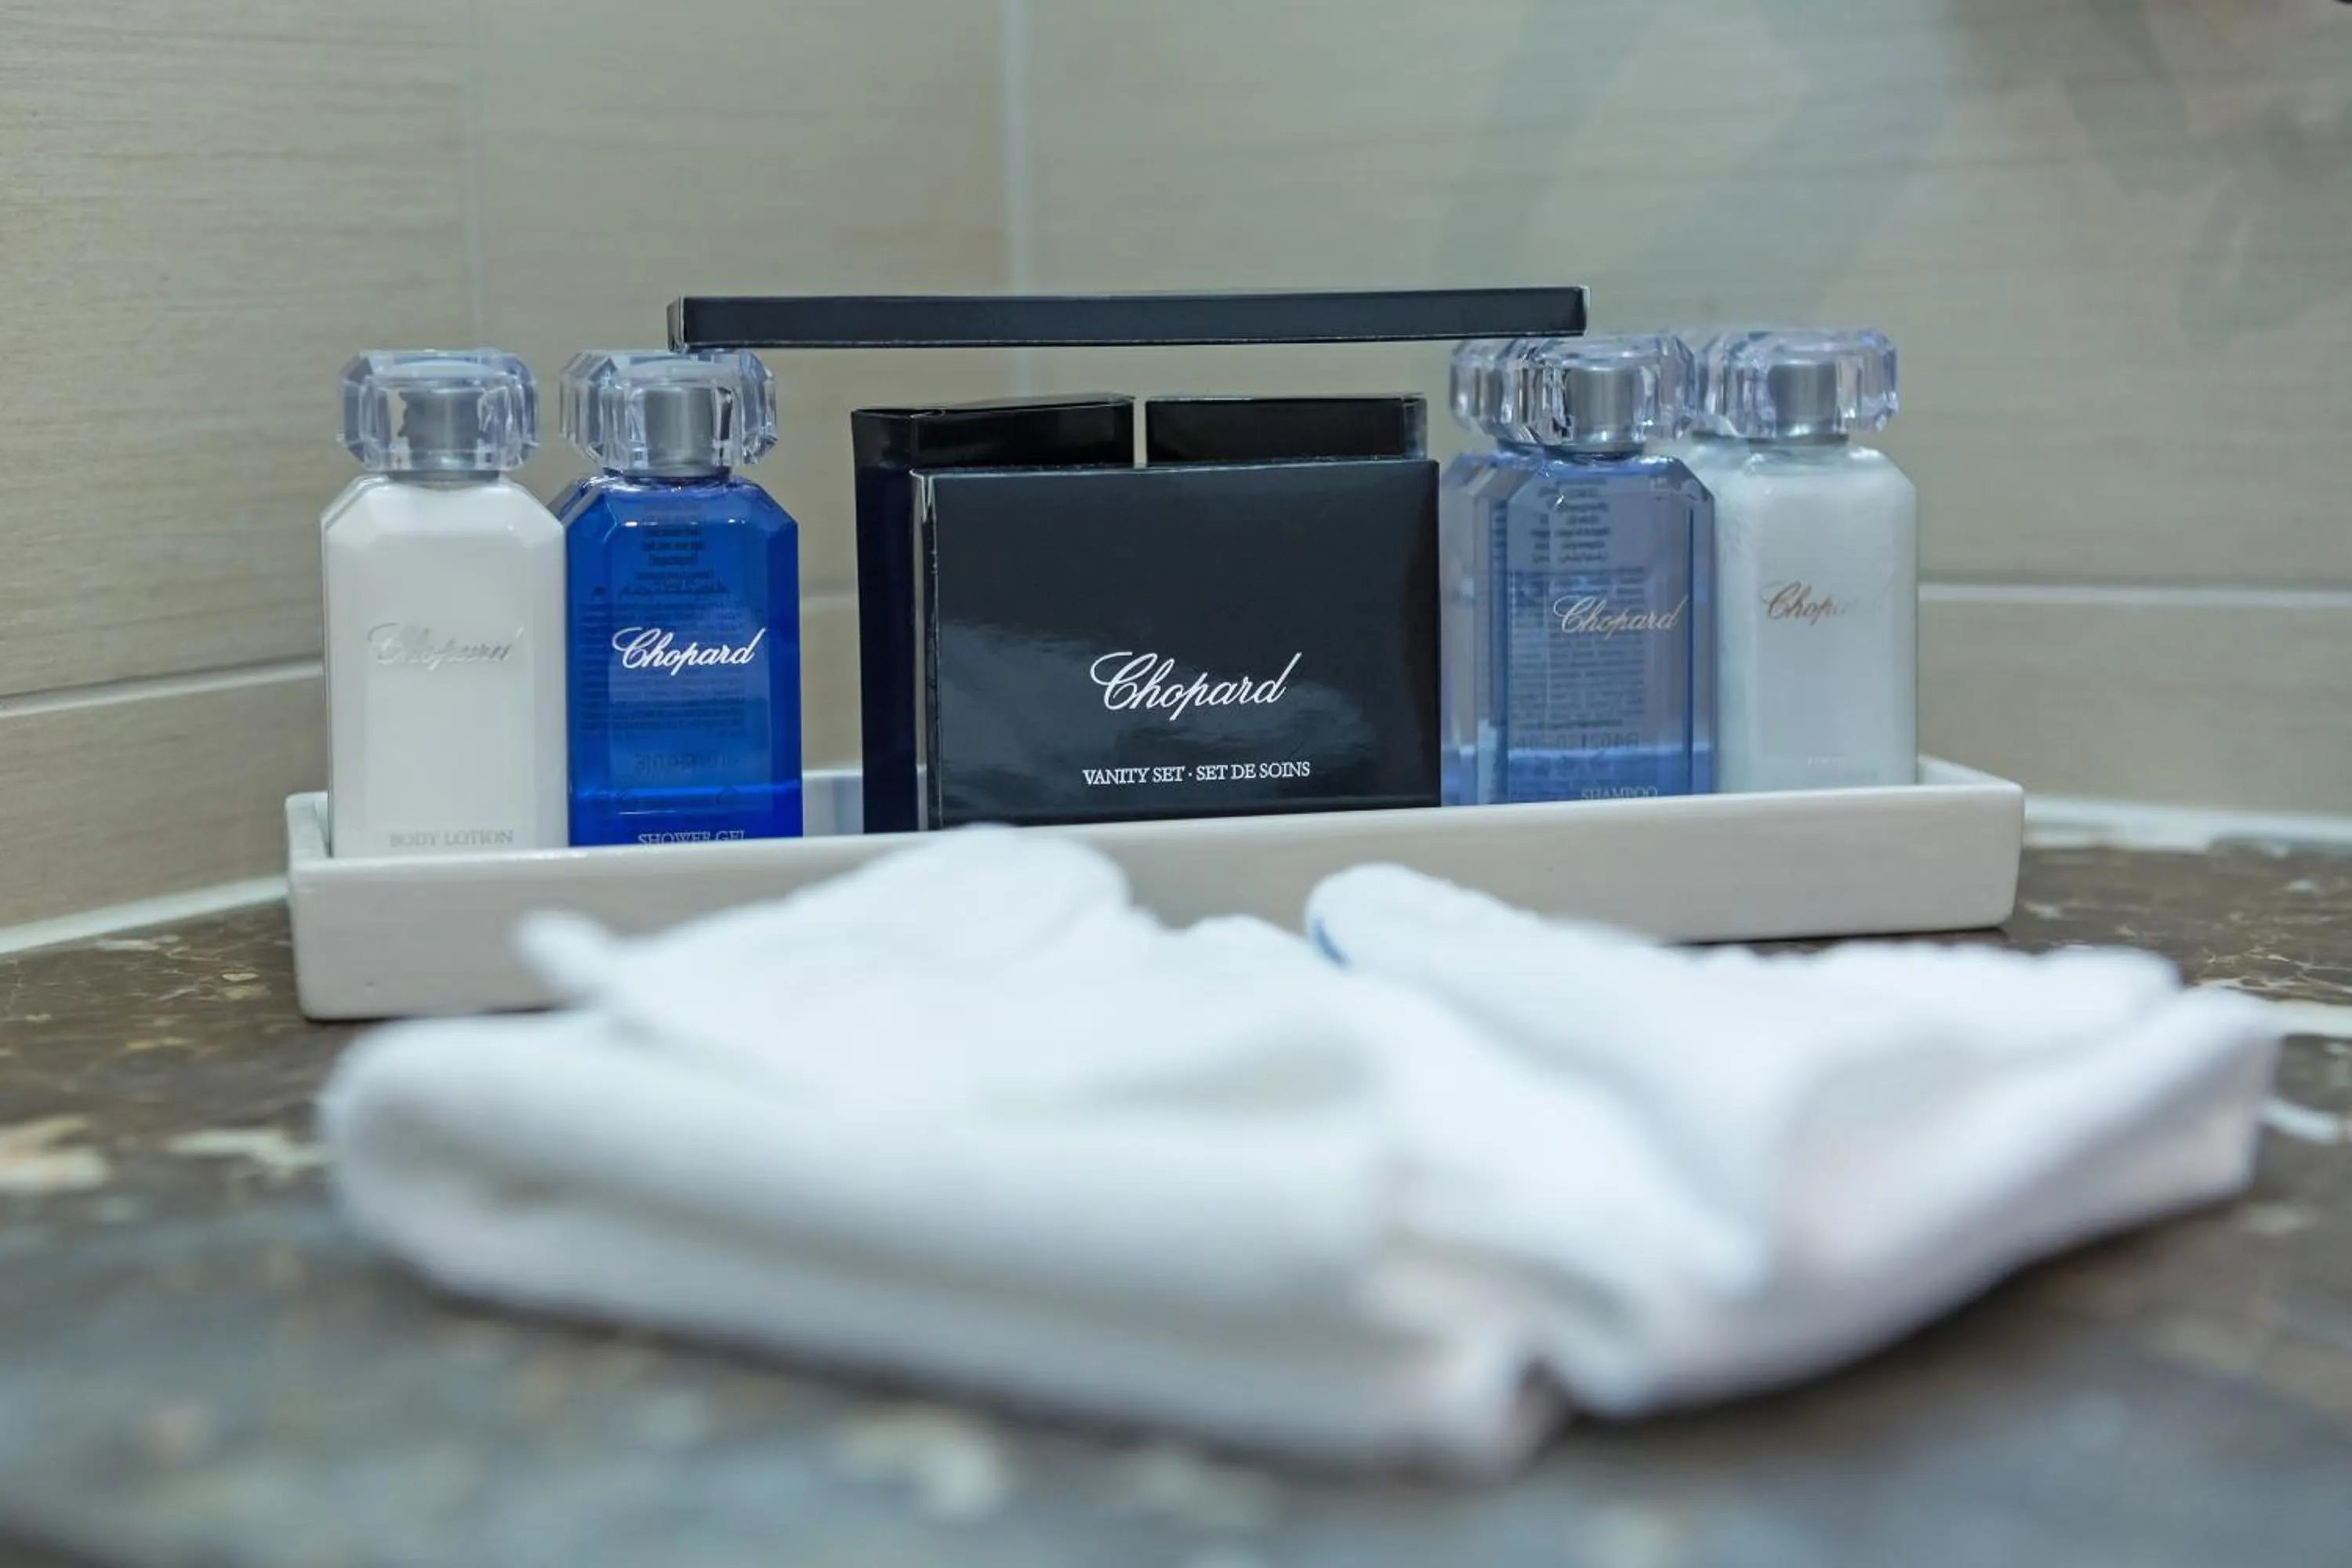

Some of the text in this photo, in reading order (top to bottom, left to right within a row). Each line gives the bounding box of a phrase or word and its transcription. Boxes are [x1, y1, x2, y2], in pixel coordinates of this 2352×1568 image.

[1553, 594, 1689, 640] Chopard
[612, 627, 766, 676] Chopard
[1090, 652, 1302, 720] Chopard
[1082, 761, 1311, 786] VANITY SET SET DE SOINS
[390, 829, 514, 848] BODY LOTION
[638, 831, 711, 844] SHOWER
